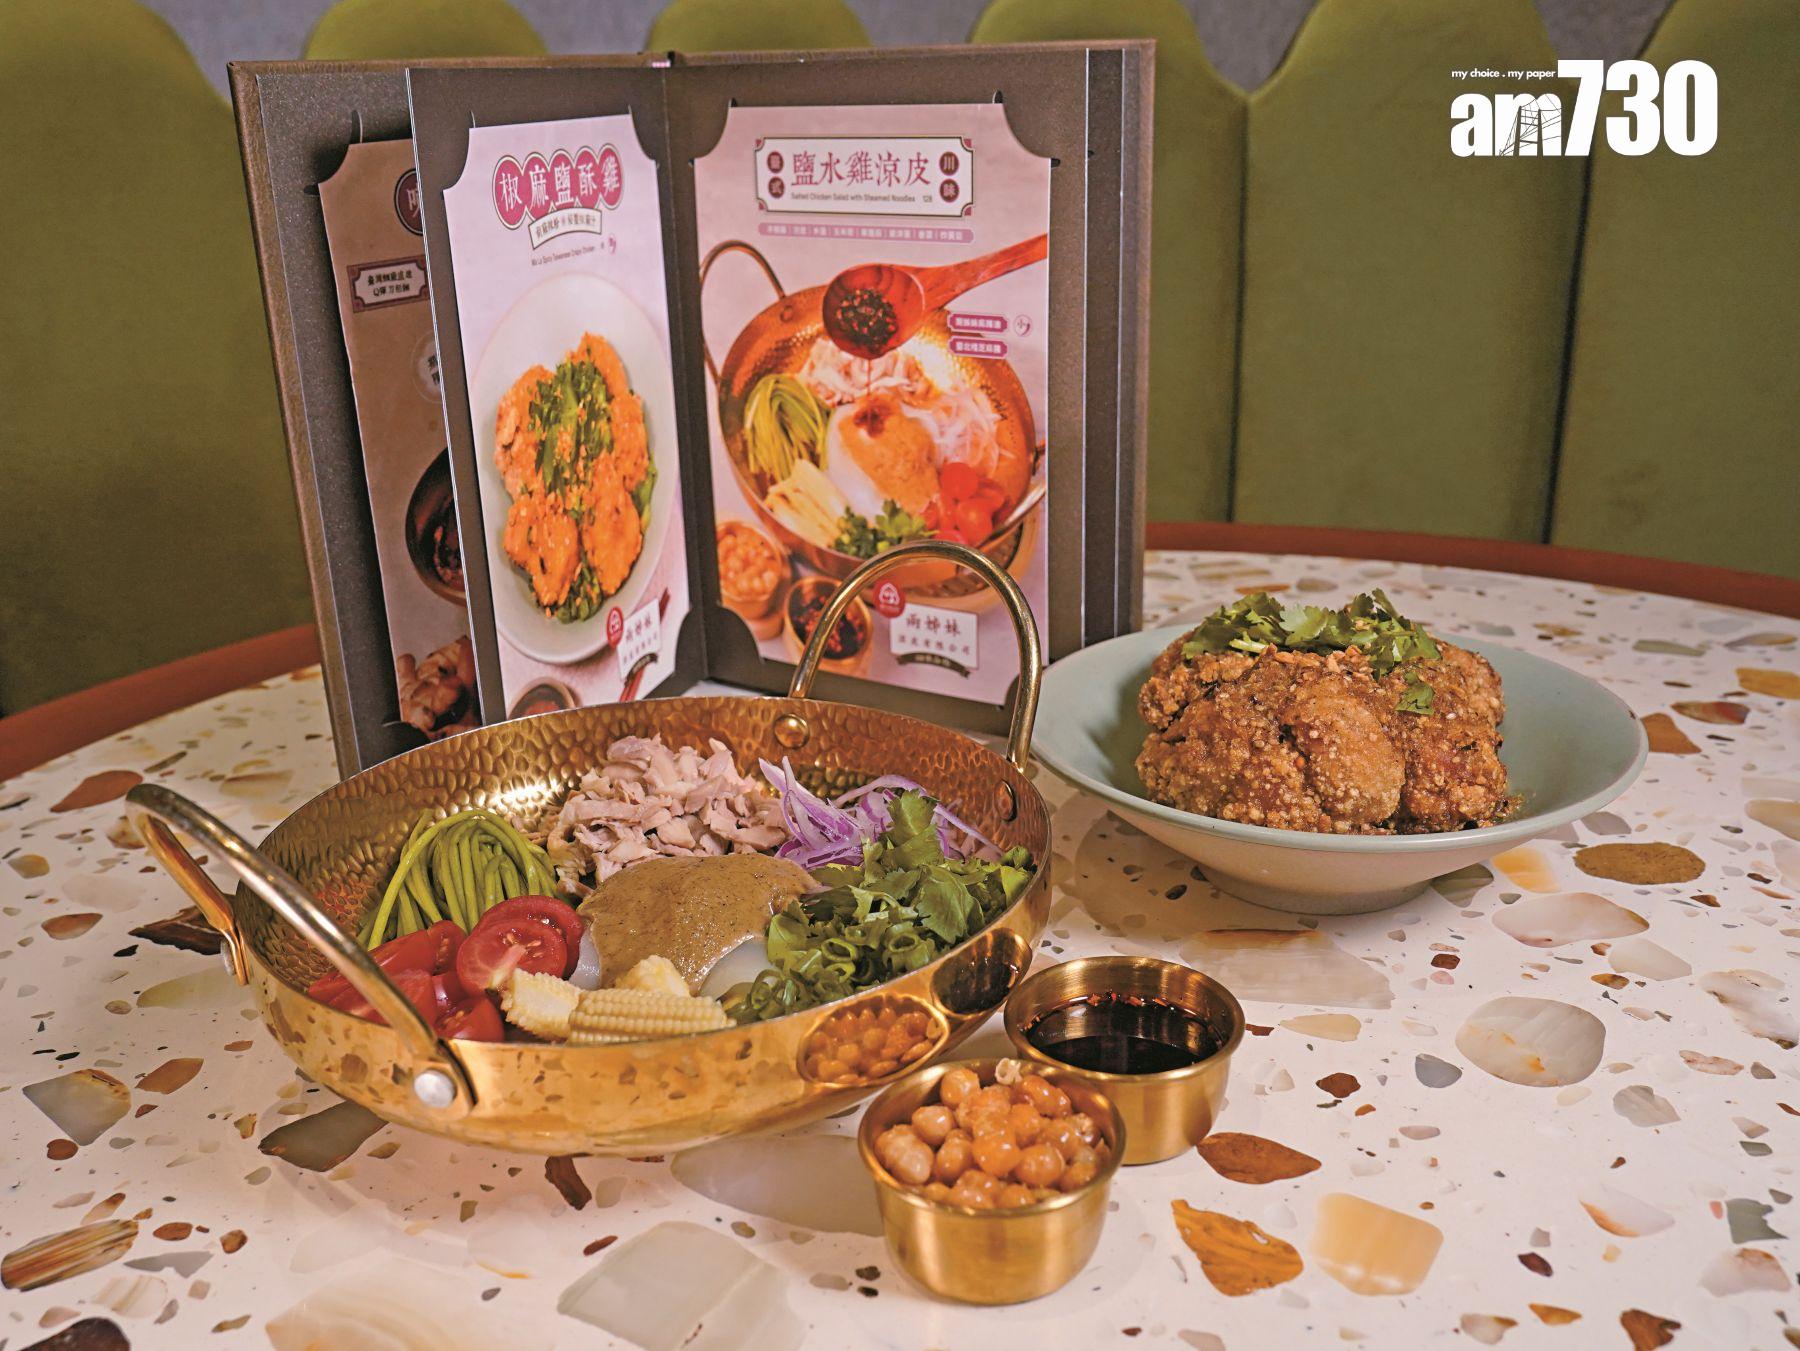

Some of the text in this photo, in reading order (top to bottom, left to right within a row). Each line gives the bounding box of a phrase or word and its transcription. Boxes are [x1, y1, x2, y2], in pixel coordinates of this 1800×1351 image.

[499, 155, 620, 213] 椒麻鹽酥雞
